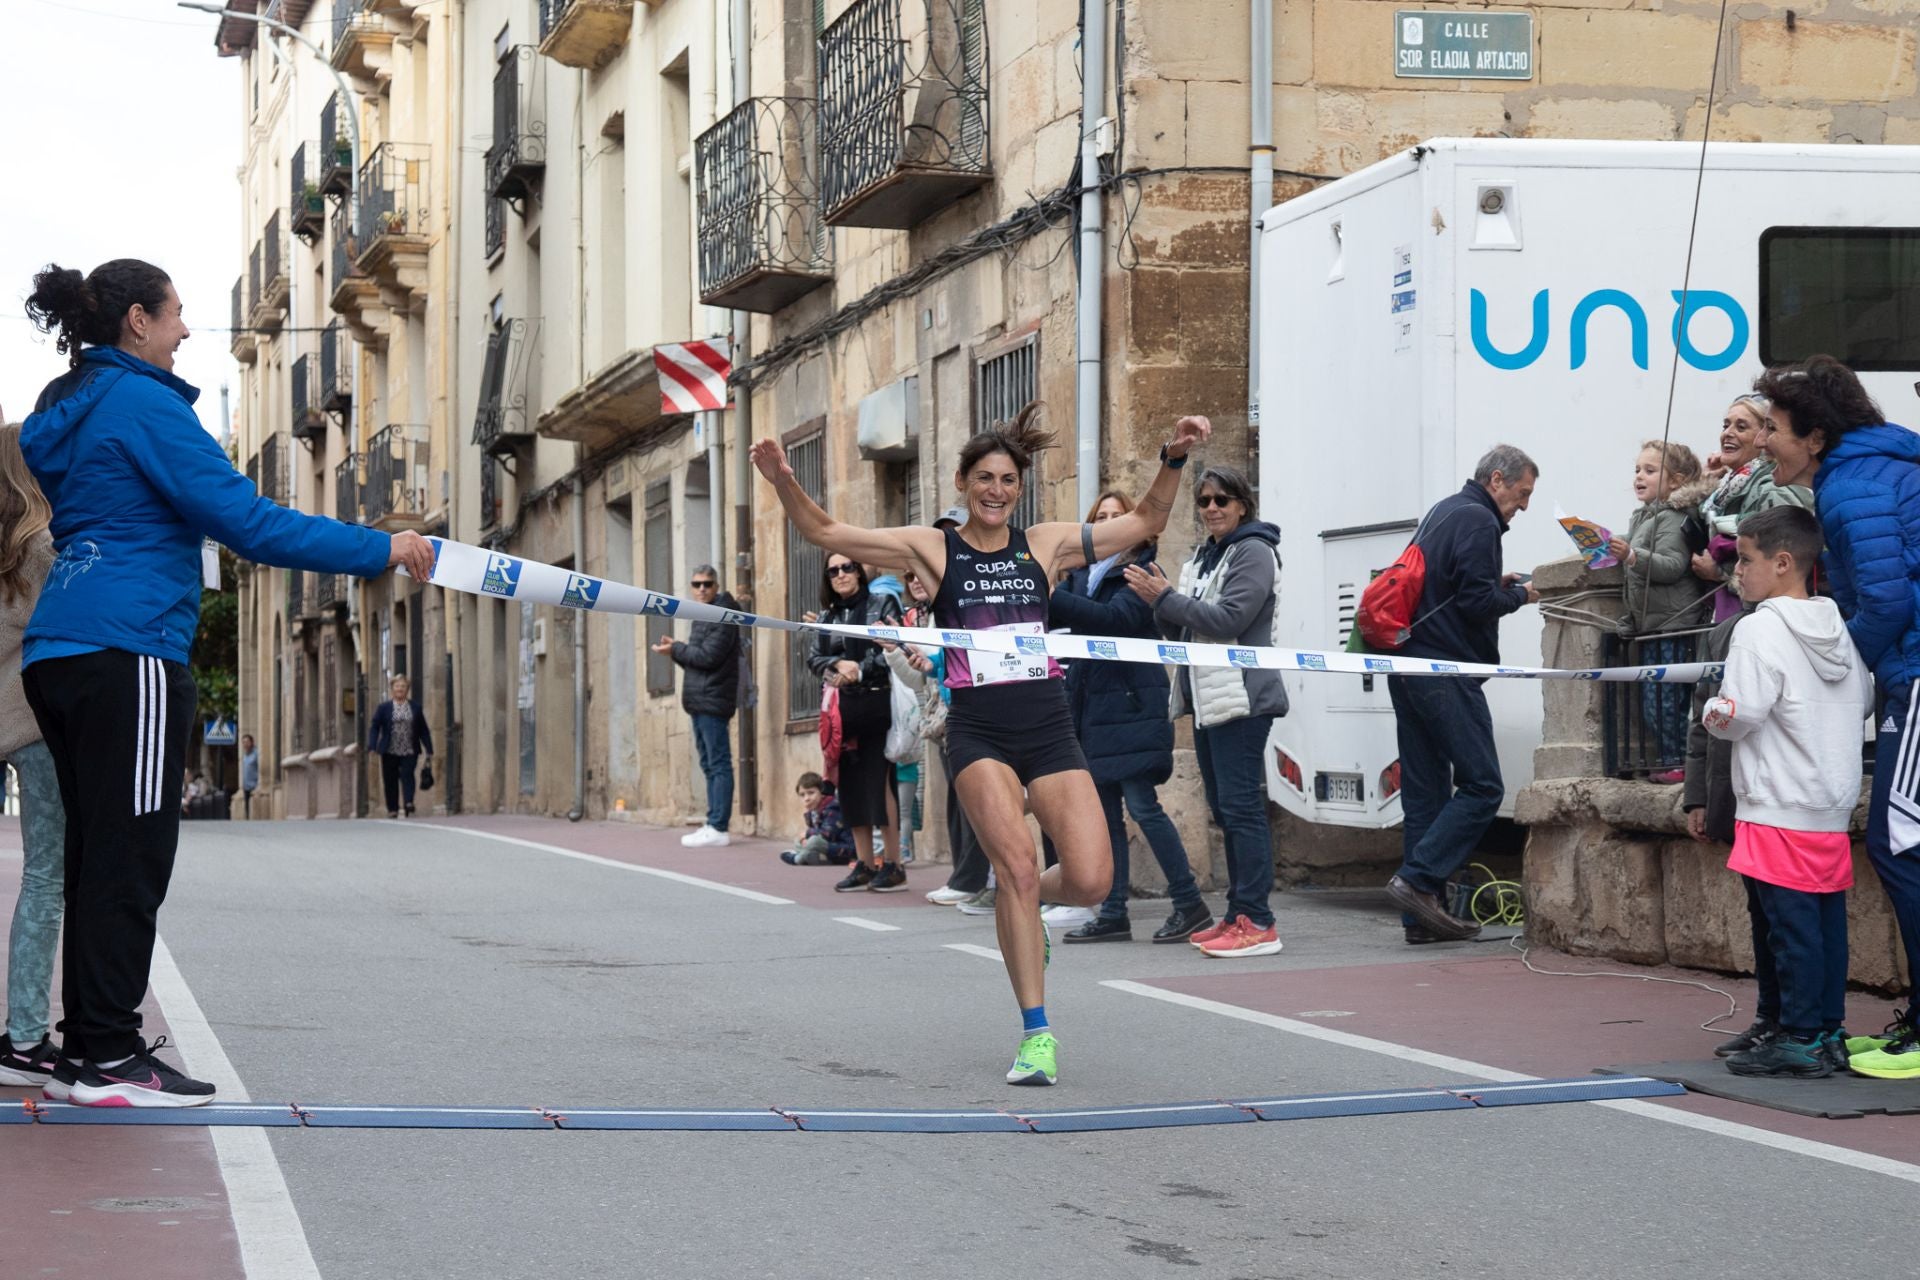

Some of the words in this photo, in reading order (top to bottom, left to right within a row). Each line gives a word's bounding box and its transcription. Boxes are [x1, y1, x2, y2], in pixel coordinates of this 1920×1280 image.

[1445, 22, 1489, 38] CALLE
[1400, 49, 1422, 68] SOR
[1431, 50, 1470, 69] ELADIA
[1476, 51, 1528, 70] ARTACHO
[975, 560, 1017, 574] CUPA
[483, 584, 507, 595] RIOJA
[964, 580, 976, 591] O
[980, 579, 1035, 591] BARCO
